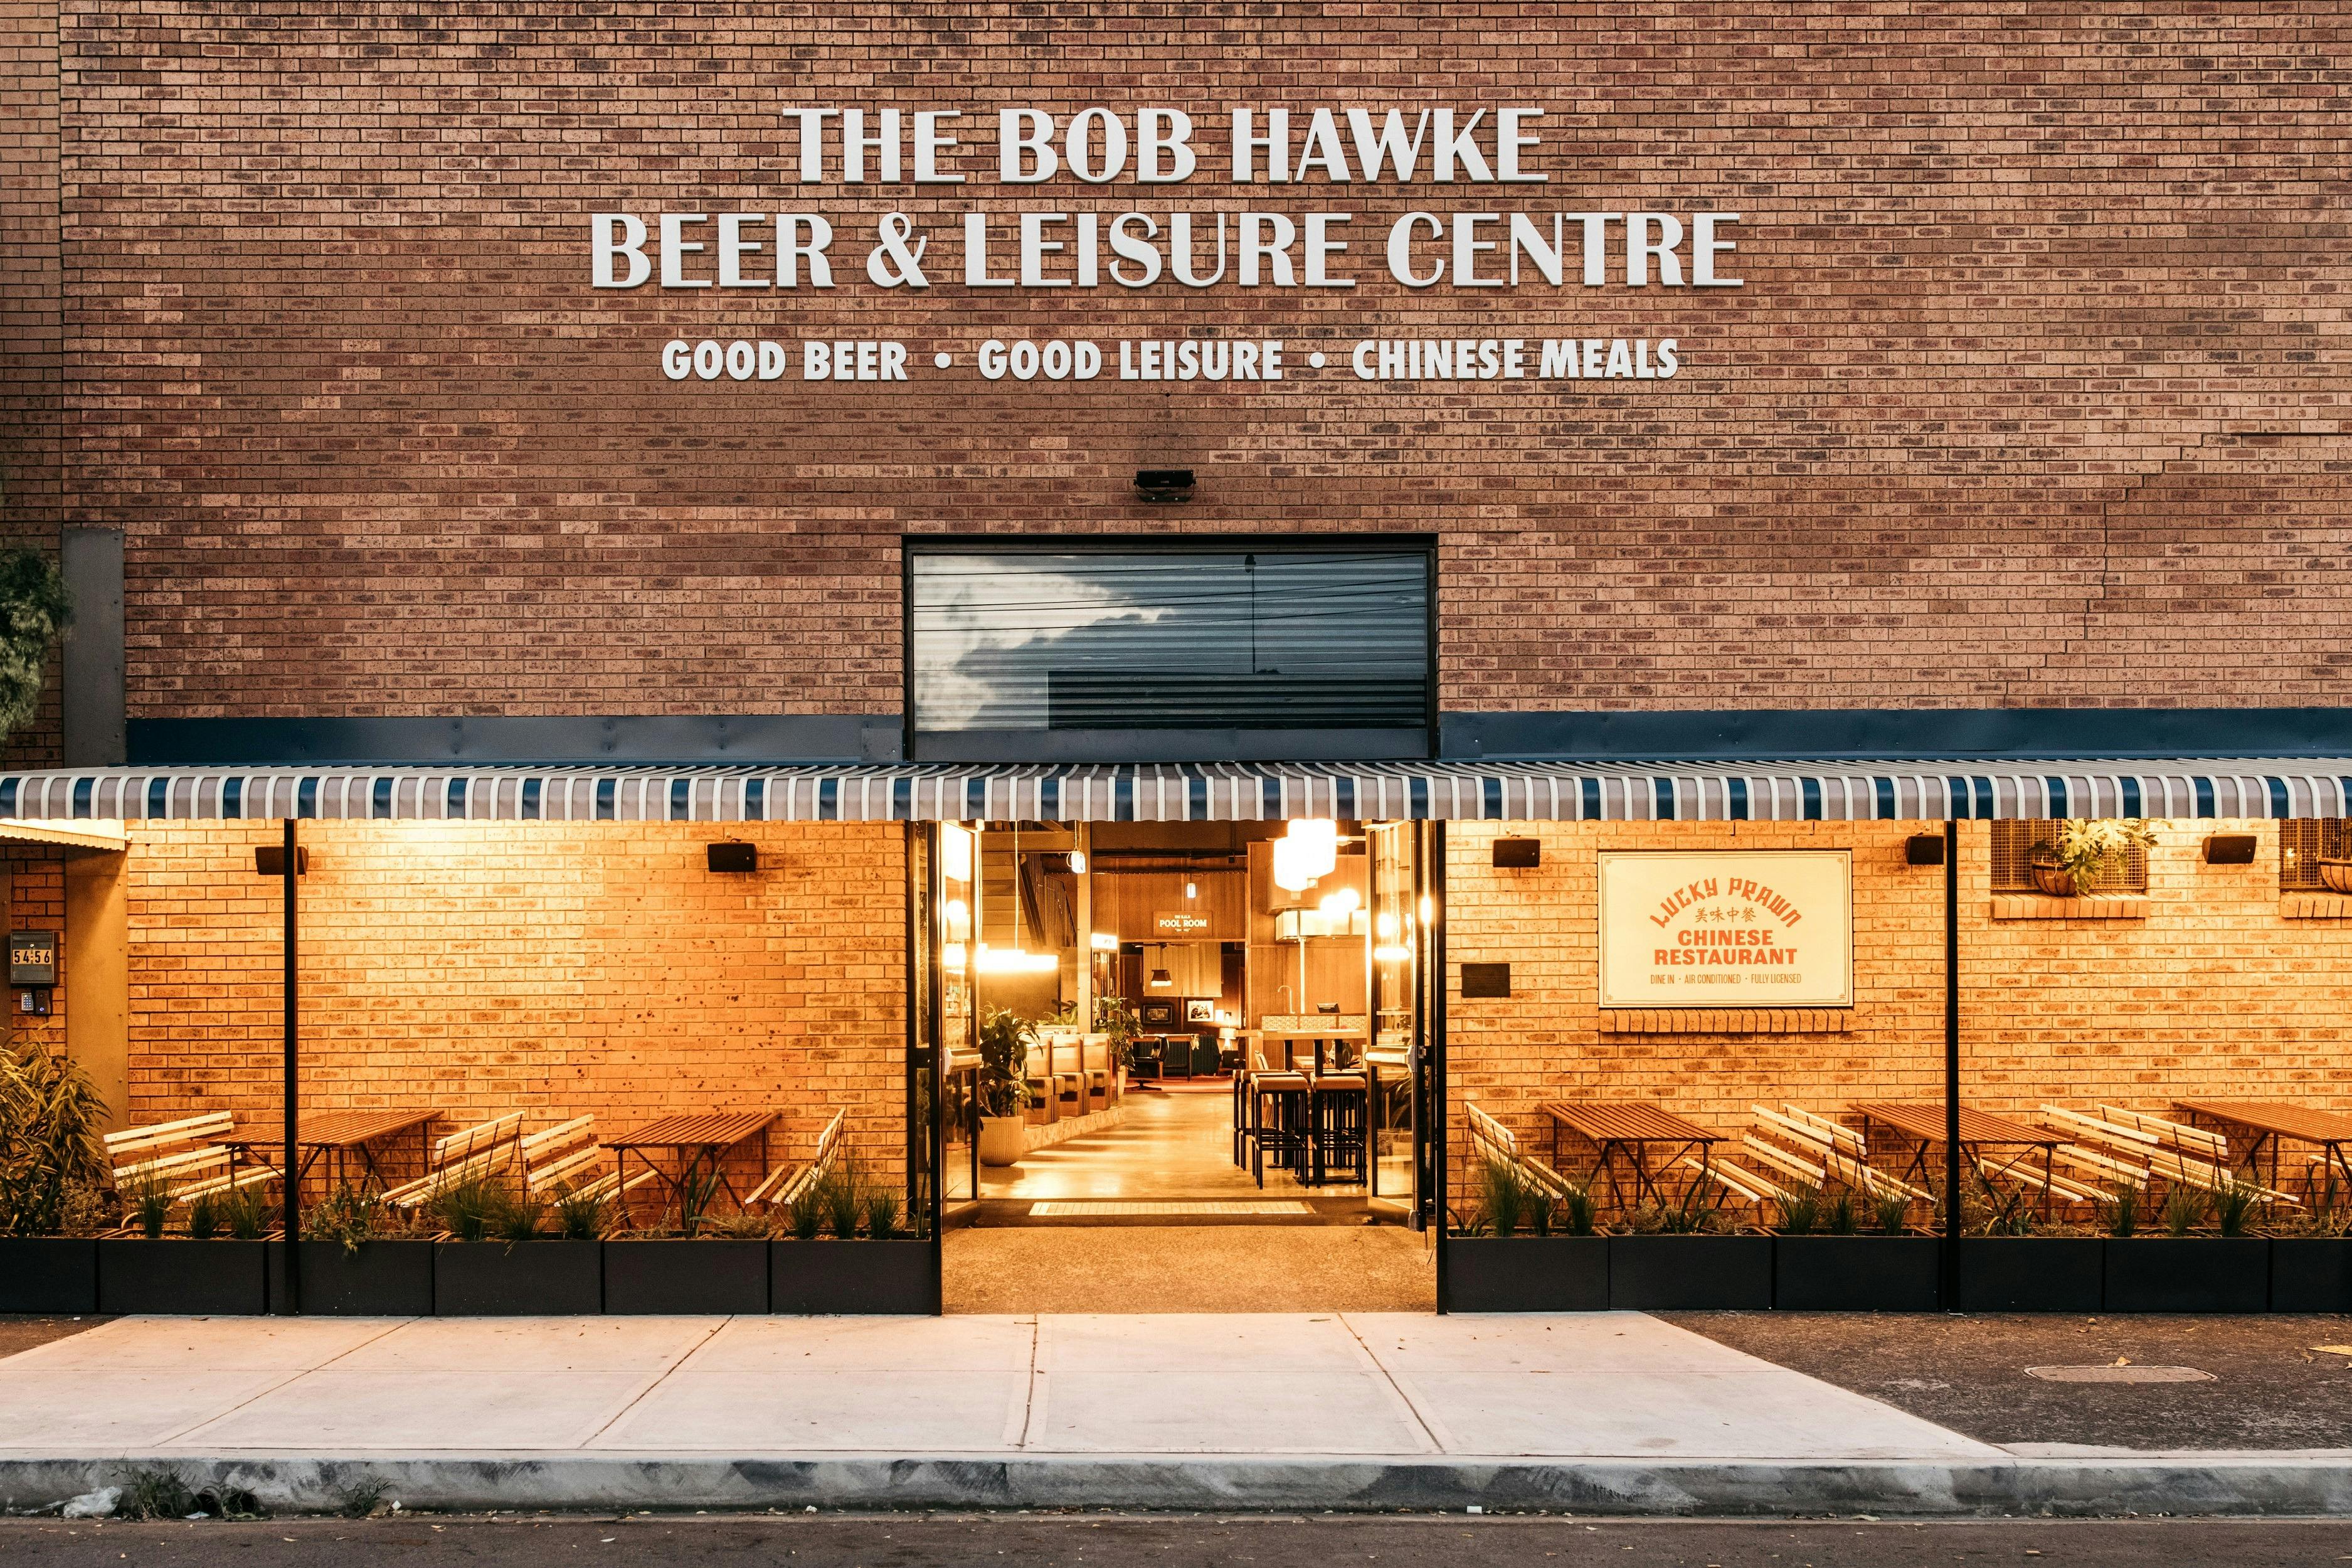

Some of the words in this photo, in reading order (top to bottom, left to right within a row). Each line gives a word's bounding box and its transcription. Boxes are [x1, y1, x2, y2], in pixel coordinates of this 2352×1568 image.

[781, 107, 966, 182] THE
[999, 107, 1197, 183] BOB
[1231, 107, 1549, 182] HAWKE
[591, 212, 837, 288] BEER
[866, 211, 931, 288] &
[963, 212, 1356, 287] LEISURE
[1385, 211, 1745, 287] CENTRE
[661, 339, 787, 380] GOOD
[803, 340, 909, 380] BEER
[977, 339, 1102, 380] GOOD
[1119, 339, 1283, 380] LEISURE
[1352, 339, 1525, 379] CHINESE
[1539, 338, 1679, 379] MEALS
[1650, 877, 1719, 929] LUCKY
[1728, 877, 1802, 928] PRAWN
[1159, 919, 1181, 927] POOL
[1183, 919, 1207, 927] ROOM
[1695, 907, 1757, 923] 美味中餐
[1677, 929, 1774, 946] CHINESE
[1654, 948, 1798, 965] RESTAURANT
[1650, 974, 1666, 984] DINE
[1667, 974, 1675, 984] IN
[1684, 974, 1696, 984] AIR
[1697, 973, 1741, 984] CONDITIONED
[1751, 973, 1769, 983] FULLY
[1770, 973, 1802, 983] LICENSED
